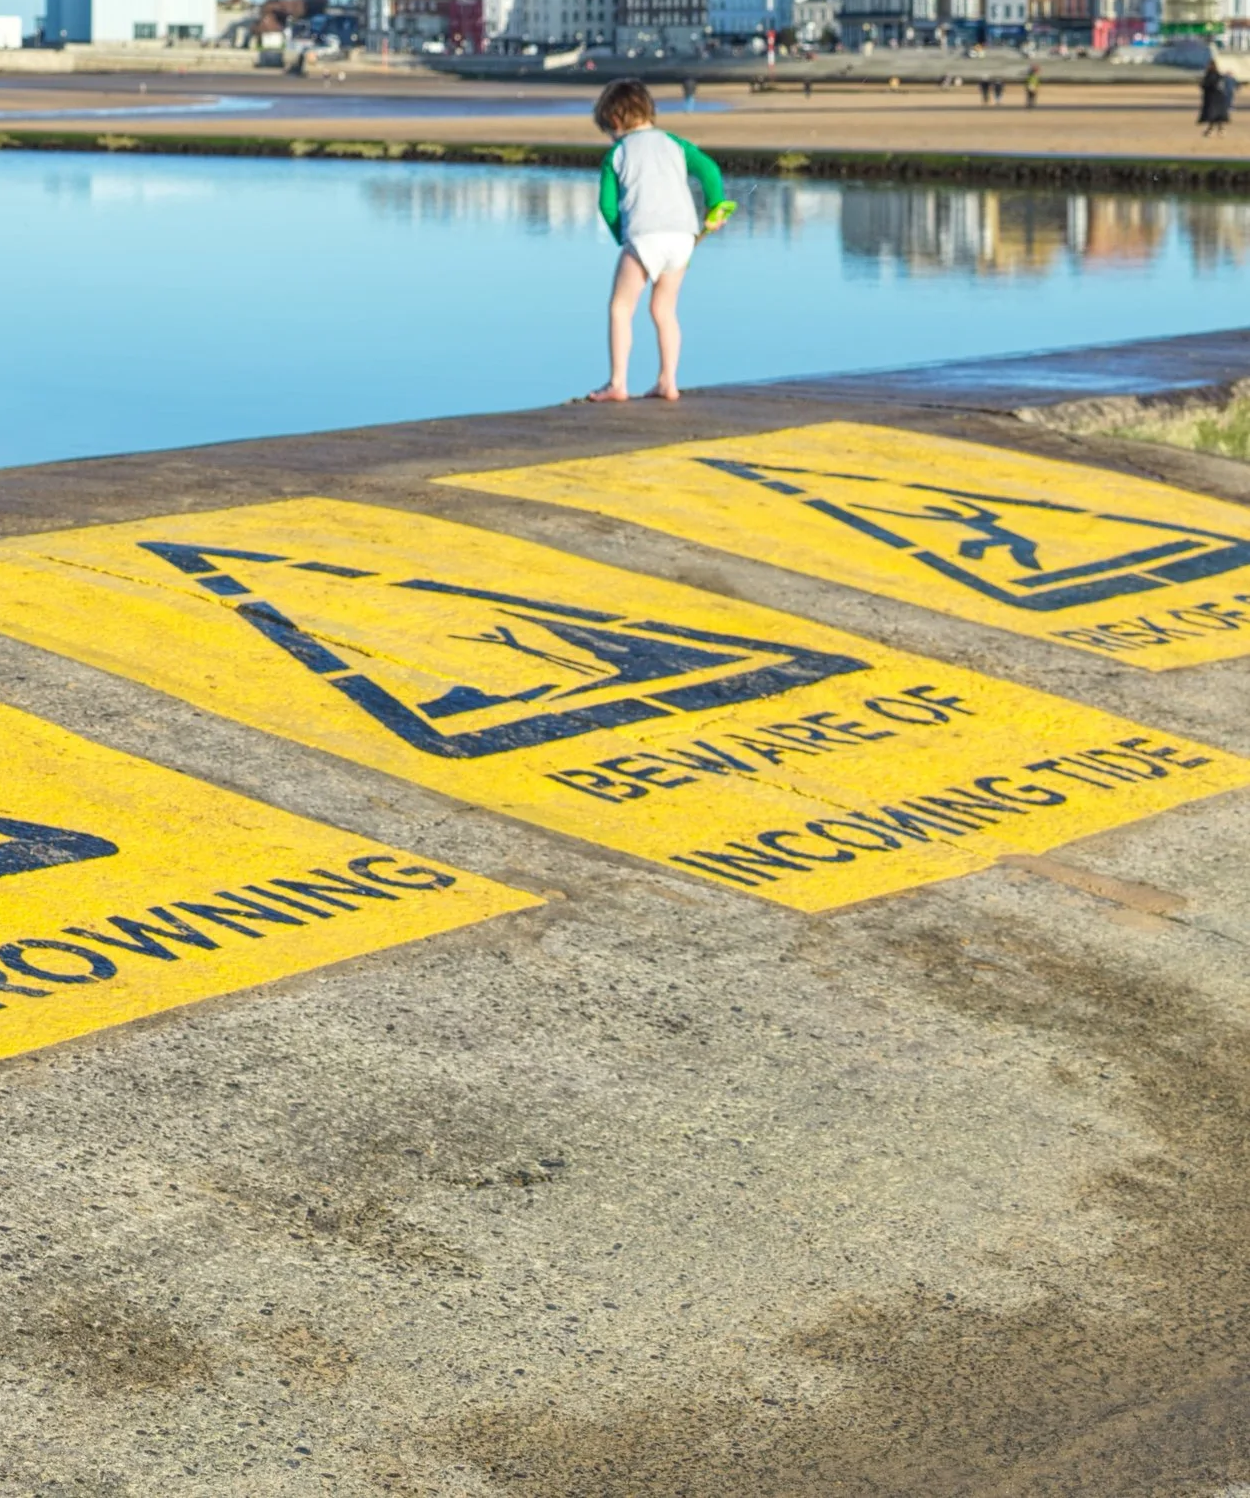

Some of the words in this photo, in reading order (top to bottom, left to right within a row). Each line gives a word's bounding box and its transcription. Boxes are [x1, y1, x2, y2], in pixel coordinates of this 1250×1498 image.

[1047, 616, 1206, 652] RISK
[543, 711, 896, 803] BEWARE
[864, 685, 978, 725] OF
[669, 776, 1068, 886] INCOMING
[1023, 737, 1212, 790] TIDE
